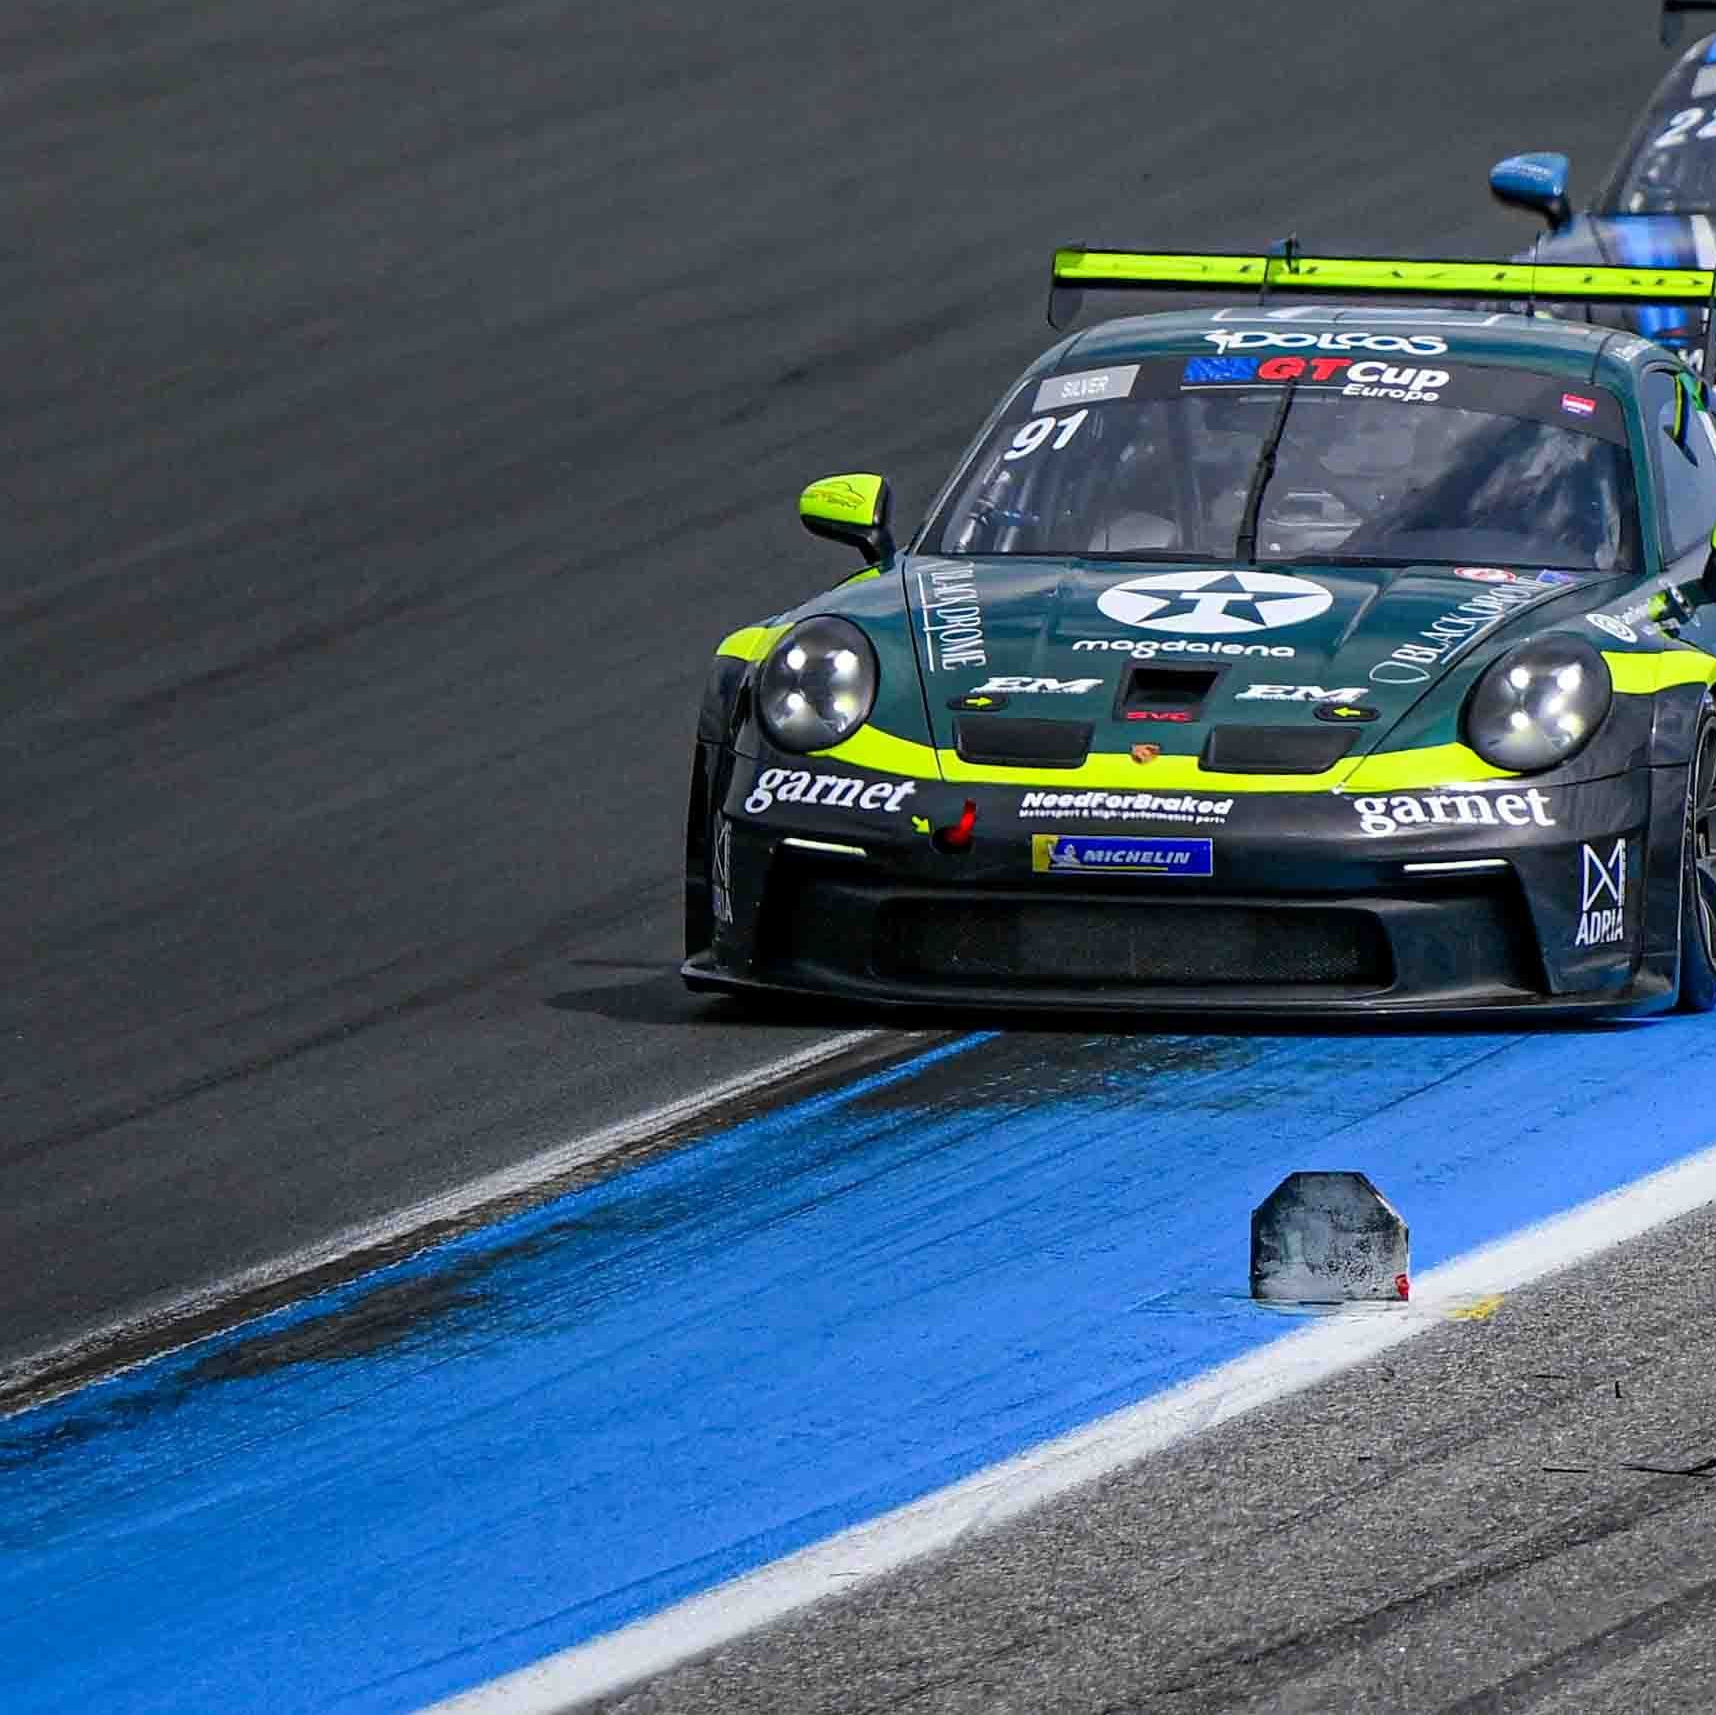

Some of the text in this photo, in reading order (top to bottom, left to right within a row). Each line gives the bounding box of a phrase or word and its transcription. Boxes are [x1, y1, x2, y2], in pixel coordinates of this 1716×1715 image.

[1257, 356, 1450, 391] GT Cup
[1342, 384, 1440, 402] Europe
[1003, 409, 1089, 461] 91
[1072, 637, 1296, 659] magdalena
[745, 766, 915, 813] garnet
[1354, 788, 1556, 837] garnet
[1083, 849, 1192, 865] MICHELIN
[1575, 906, 1624, 947] ADRIA
